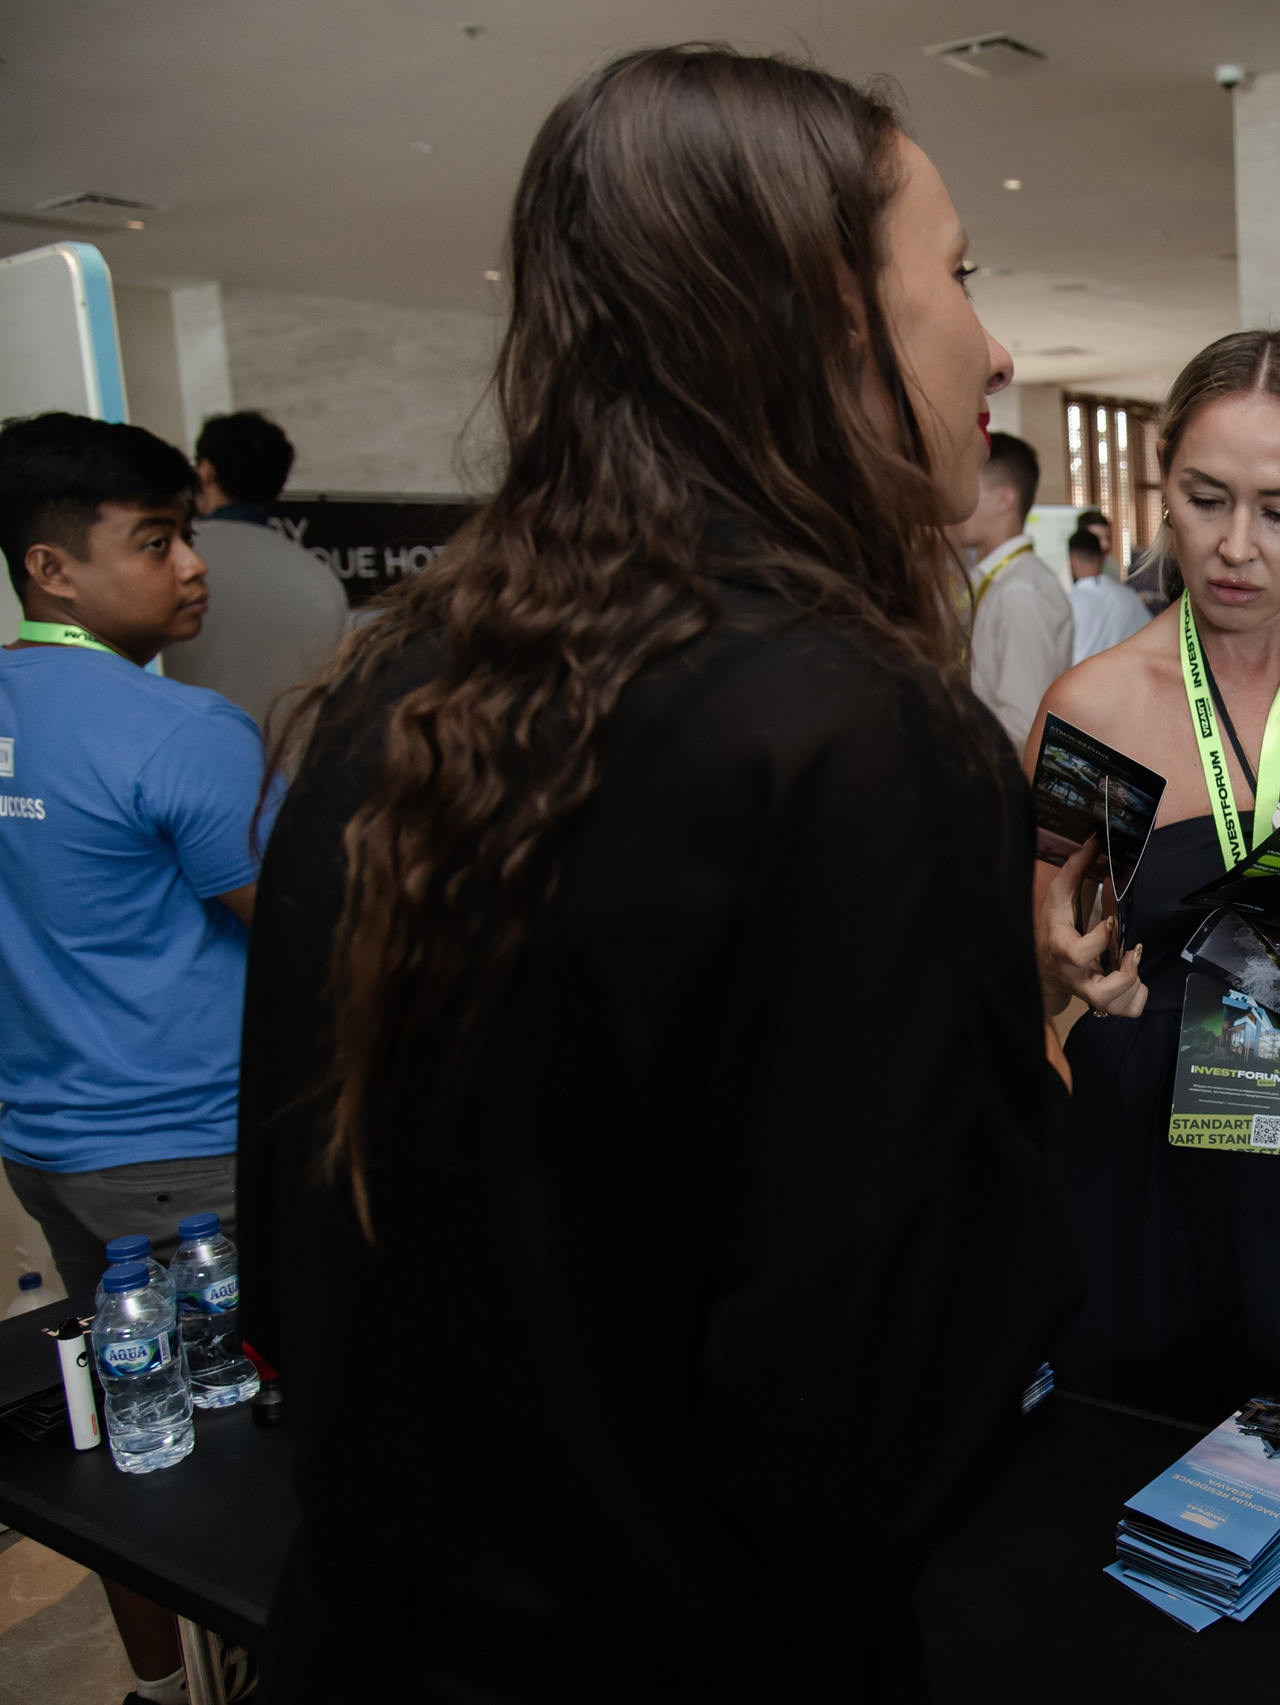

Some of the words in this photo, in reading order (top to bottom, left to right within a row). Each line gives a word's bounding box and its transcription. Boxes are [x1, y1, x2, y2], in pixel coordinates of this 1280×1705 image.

[1196, 698, 1212, 738] VIZART
[1210, 750, 1241, 864] NVESTFORUM
[1172, 1119, 1253, 1129] STANDART
[109, 1346, 148, 1361] AQUA
[1173, 1473, 1230, 1499] RESIDENCE
[1208, 1479, 1253, 1500] BERAWA
[1231, 1495, 1279, 1518] MAGNUM
